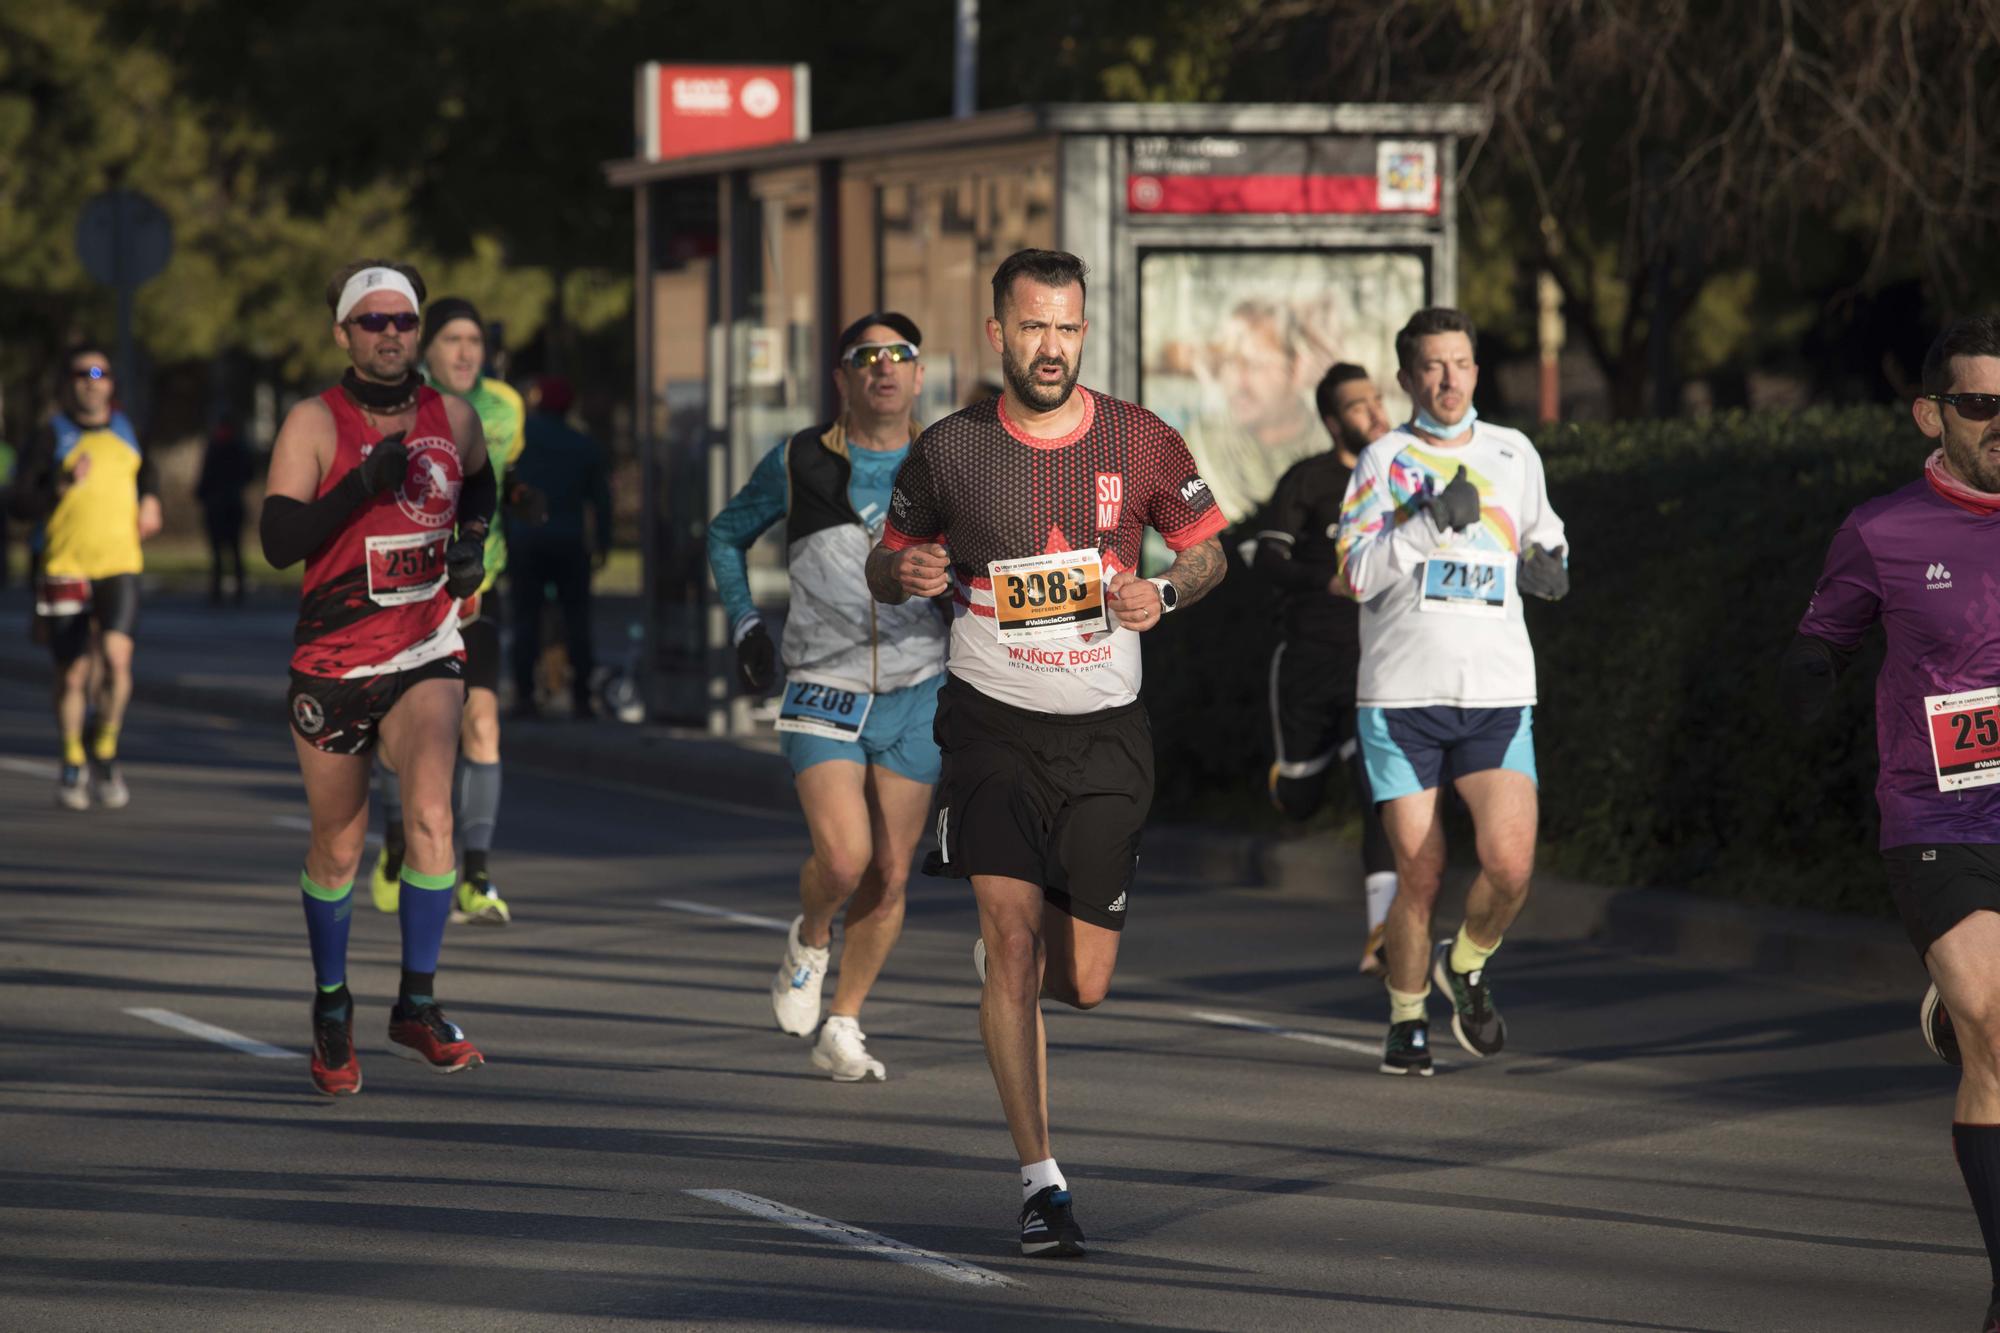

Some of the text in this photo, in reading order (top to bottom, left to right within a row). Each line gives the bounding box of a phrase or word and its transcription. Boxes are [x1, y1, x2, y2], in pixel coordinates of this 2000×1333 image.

[1098, 475, 1120, 502] SO
[1098, 503, 1112, 528] M
[1007, 568, 1088, 609] 3083
[1926, 580, 1952, 590] mobel
[1008, 645, 1112, 666] MUÑOZ BOSCH
[1008, 660, 1070, 674] INSTALACIONES
[792, 682, 856, 716] 2208
